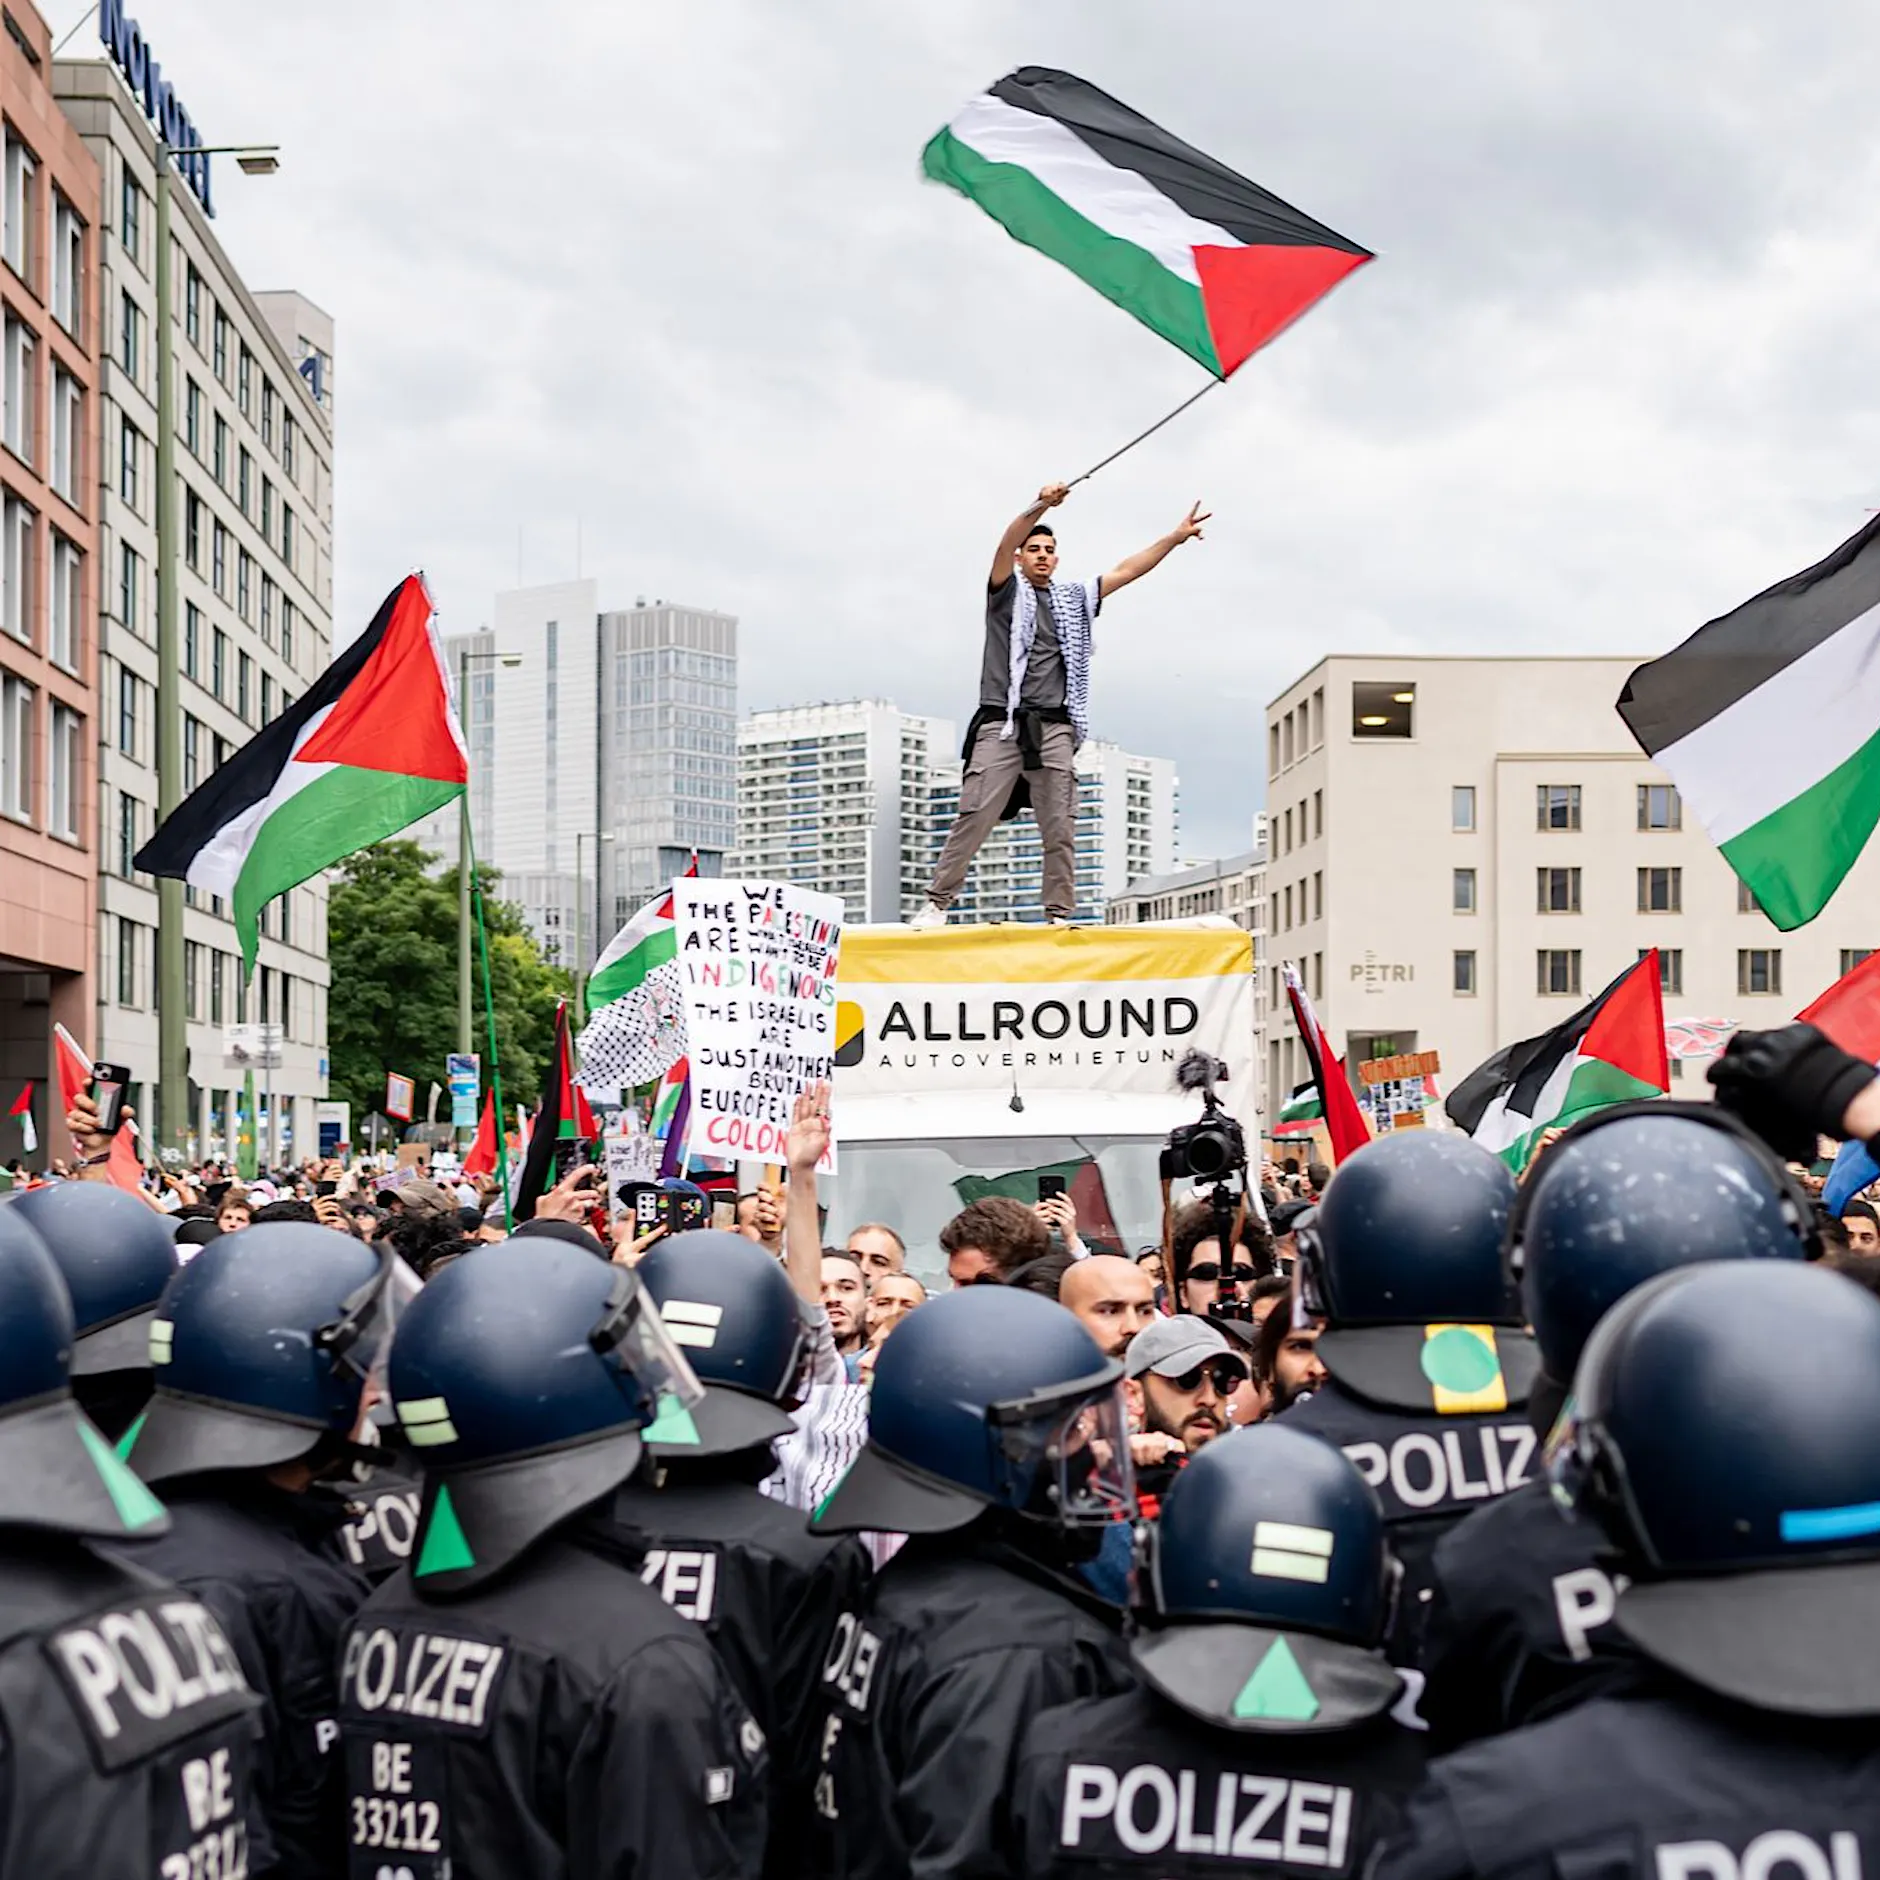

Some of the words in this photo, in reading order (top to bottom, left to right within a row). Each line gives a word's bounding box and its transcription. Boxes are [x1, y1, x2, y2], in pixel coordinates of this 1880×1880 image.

[742, 886, 784, 909] WE
[687, 902, 736, 923] THE
[684, 927, 739, 953] ARE
[688, 958, 835, 1006] INDIGENOUS
[1350, 964, 1414, 982] PETRI
[694, 1001, 738, 1023] THE
[749, 1001, 827, 1033] ISRAELIS
[879, 997, 1199, 1042] ALLROUND
[759, 1026, 791, 1048] ARE
[879, 1048, 1175, 1068] AUTOVERMIETUN
[749, 1071, 802, 1095] BRUTA
[1342, 1425, 1537, 1508] POLIZ
[372, 1741, 413, 1793] BE
[351, 1796, 441, 1853] 33212
[1061, 1763, 1352, 1869] POLIZEI
